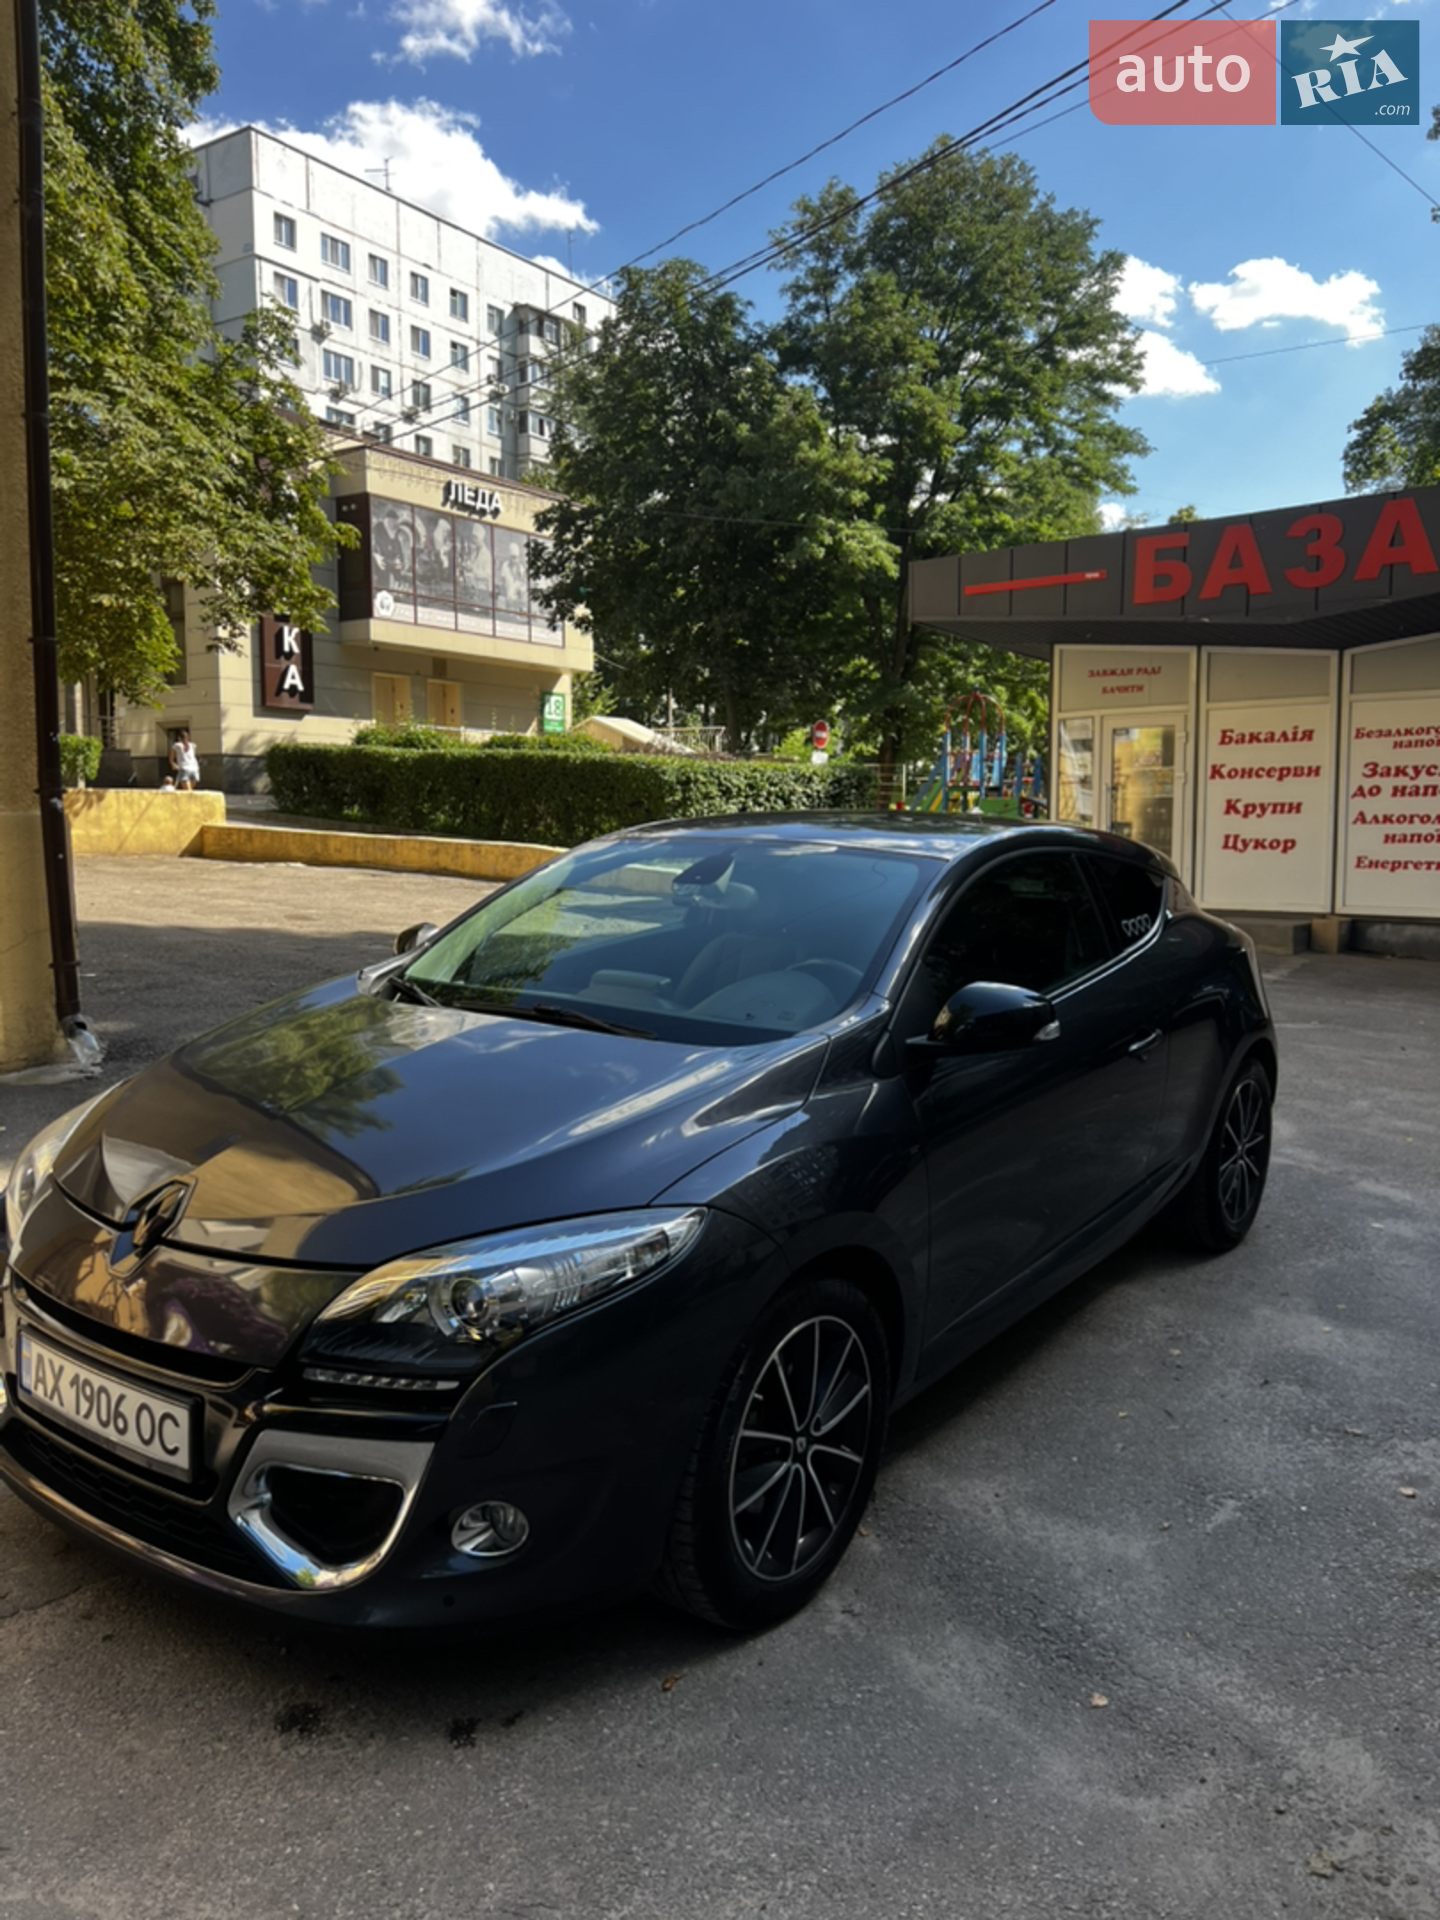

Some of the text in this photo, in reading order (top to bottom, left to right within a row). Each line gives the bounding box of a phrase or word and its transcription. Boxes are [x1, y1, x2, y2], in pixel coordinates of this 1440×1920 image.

[449, 479, 503, 513] ЛЕДА
[1133, 497, 1438, 605] БАЗА
[1136, 666, 1162, 676] РАДІ
[1101, 684, 1144, 694] БАЧИТИ
[1218, 725, 1315, 746] Бакалія
[1209, 763, 1322, 782] Консерви
[1362, 761, 1440, 781] Закус
[1351, 784, 1440, 799] до нап
[1223, 798, 1303, 818] Крупи
[1222, 833, 1297, 854] Цукор
[33, 1353, 181, 1456] AX 1906 OC
